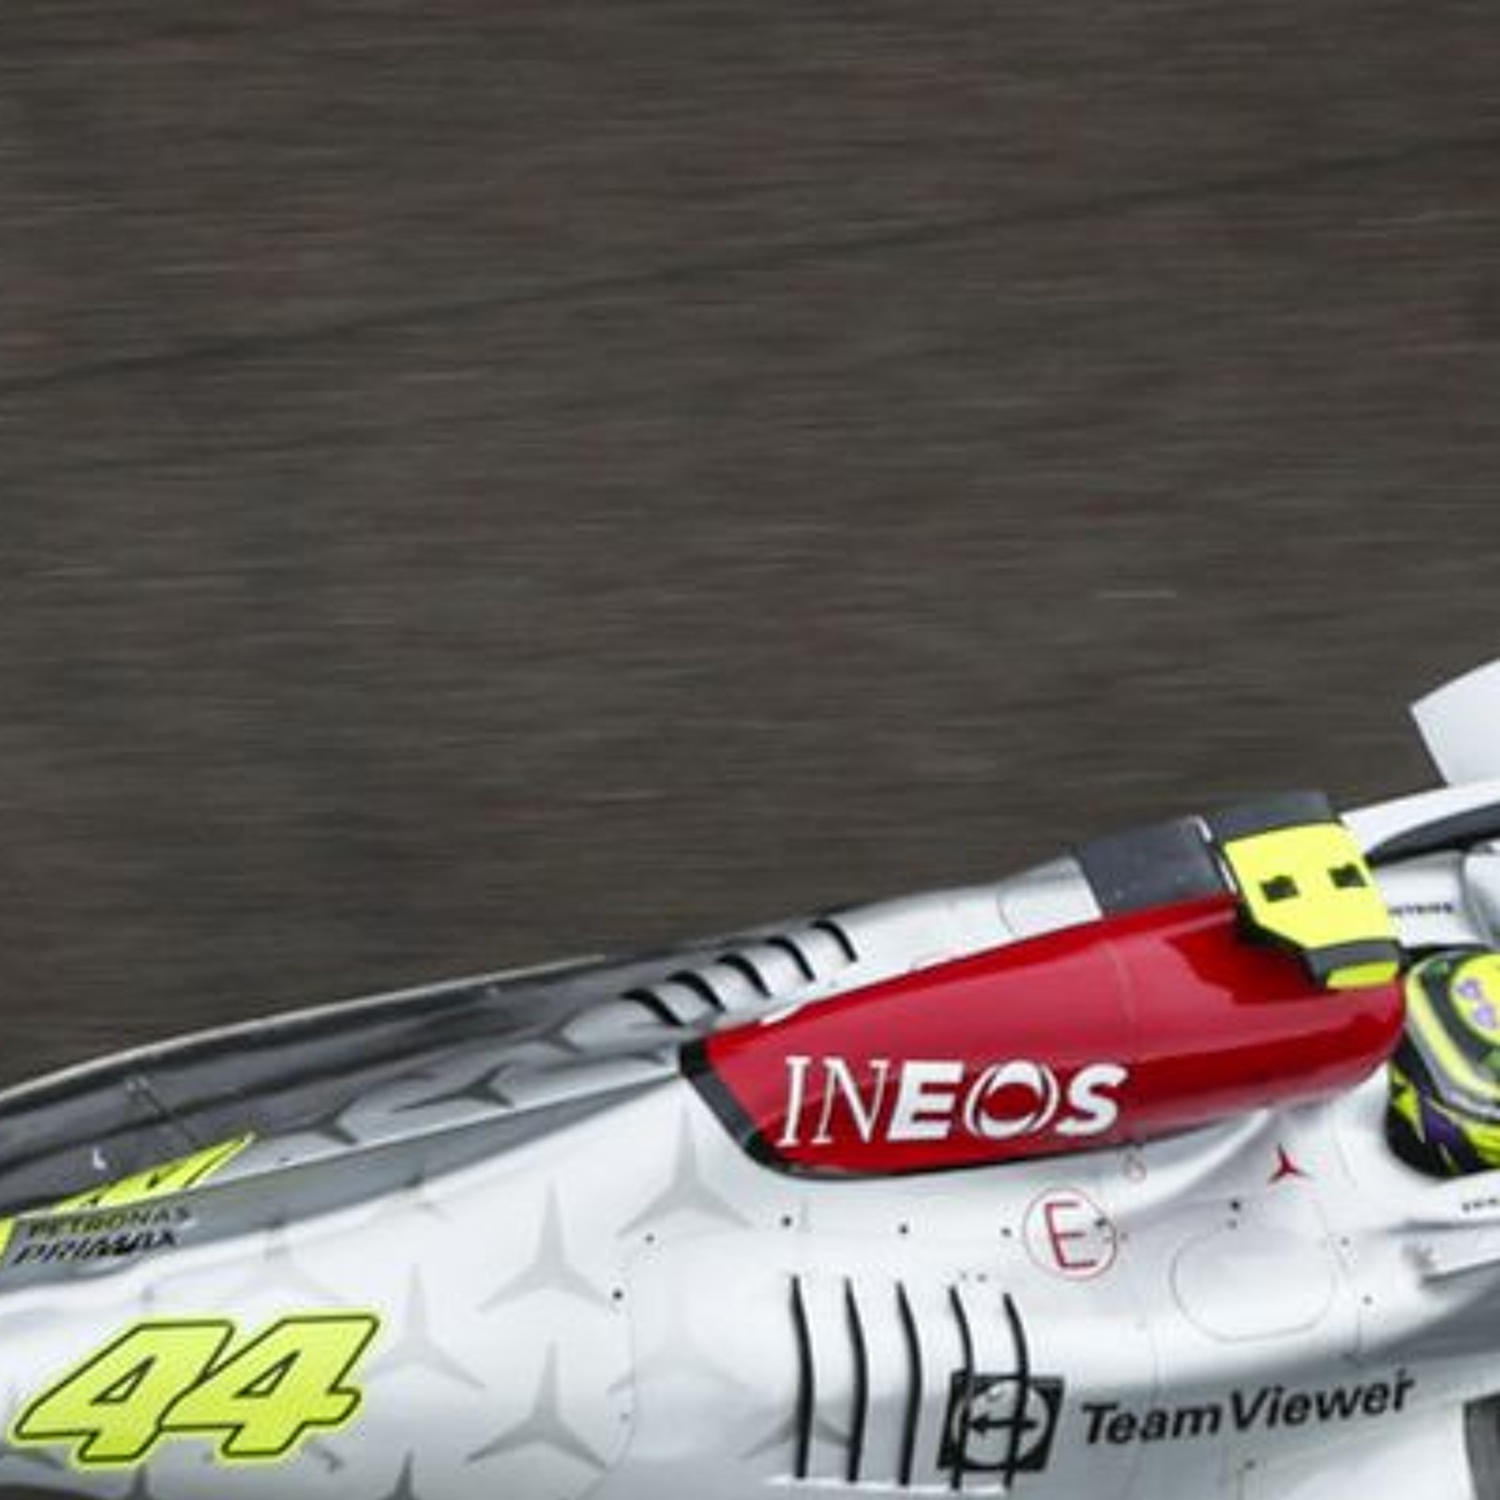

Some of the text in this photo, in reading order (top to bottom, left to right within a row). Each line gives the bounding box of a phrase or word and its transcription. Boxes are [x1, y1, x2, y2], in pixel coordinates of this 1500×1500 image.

[775, 1055, 1129, 1148] INEOS
[26, 1205, 192, 1238] PETRONAS
[1043, 1200, 1098, 1269] E
[10, 1309, 381, 1468] 44
